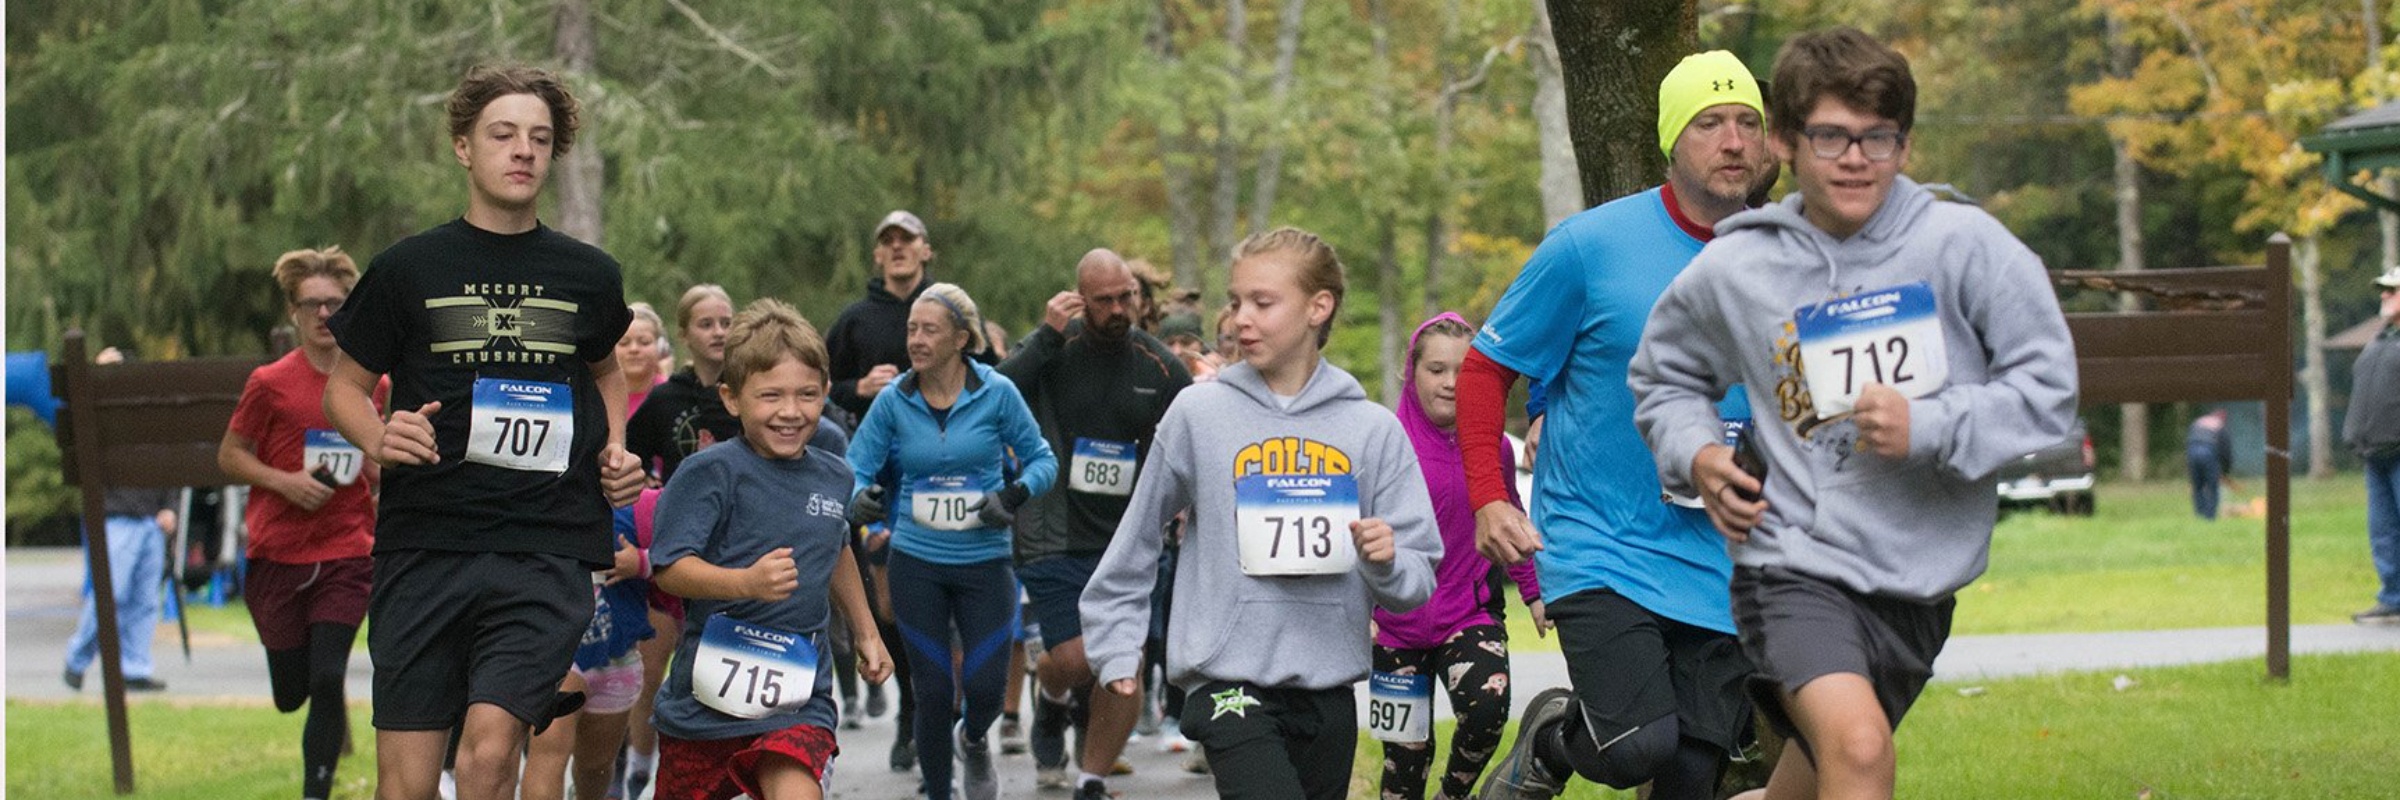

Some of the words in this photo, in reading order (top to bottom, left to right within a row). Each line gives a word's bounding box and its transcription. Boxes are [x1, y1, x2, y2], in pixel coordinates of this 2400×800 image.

[464, 283, 544, 297] MCCORT
[1827, 291, 1902, 317] FALCON
[452, 351, 556, 364] CRUSHERS
[1832, 336, 1914, 396] 712
[500, 384, 552, 395] FALCON
[493, 416, 550, 457] 707
[1084, 461, 1121, 487] 683
[1267, 478, 1332, 488] FALCON
[928, 497, 967, 522] 710
[1265, 516, 1332, 559] 713
[734, 625, 796, 646] FALCON
[718, 657, 784, 709] 715
[1373, 673, 1415, 685] FALCON
[1370, 699, 1412, 732] 697
